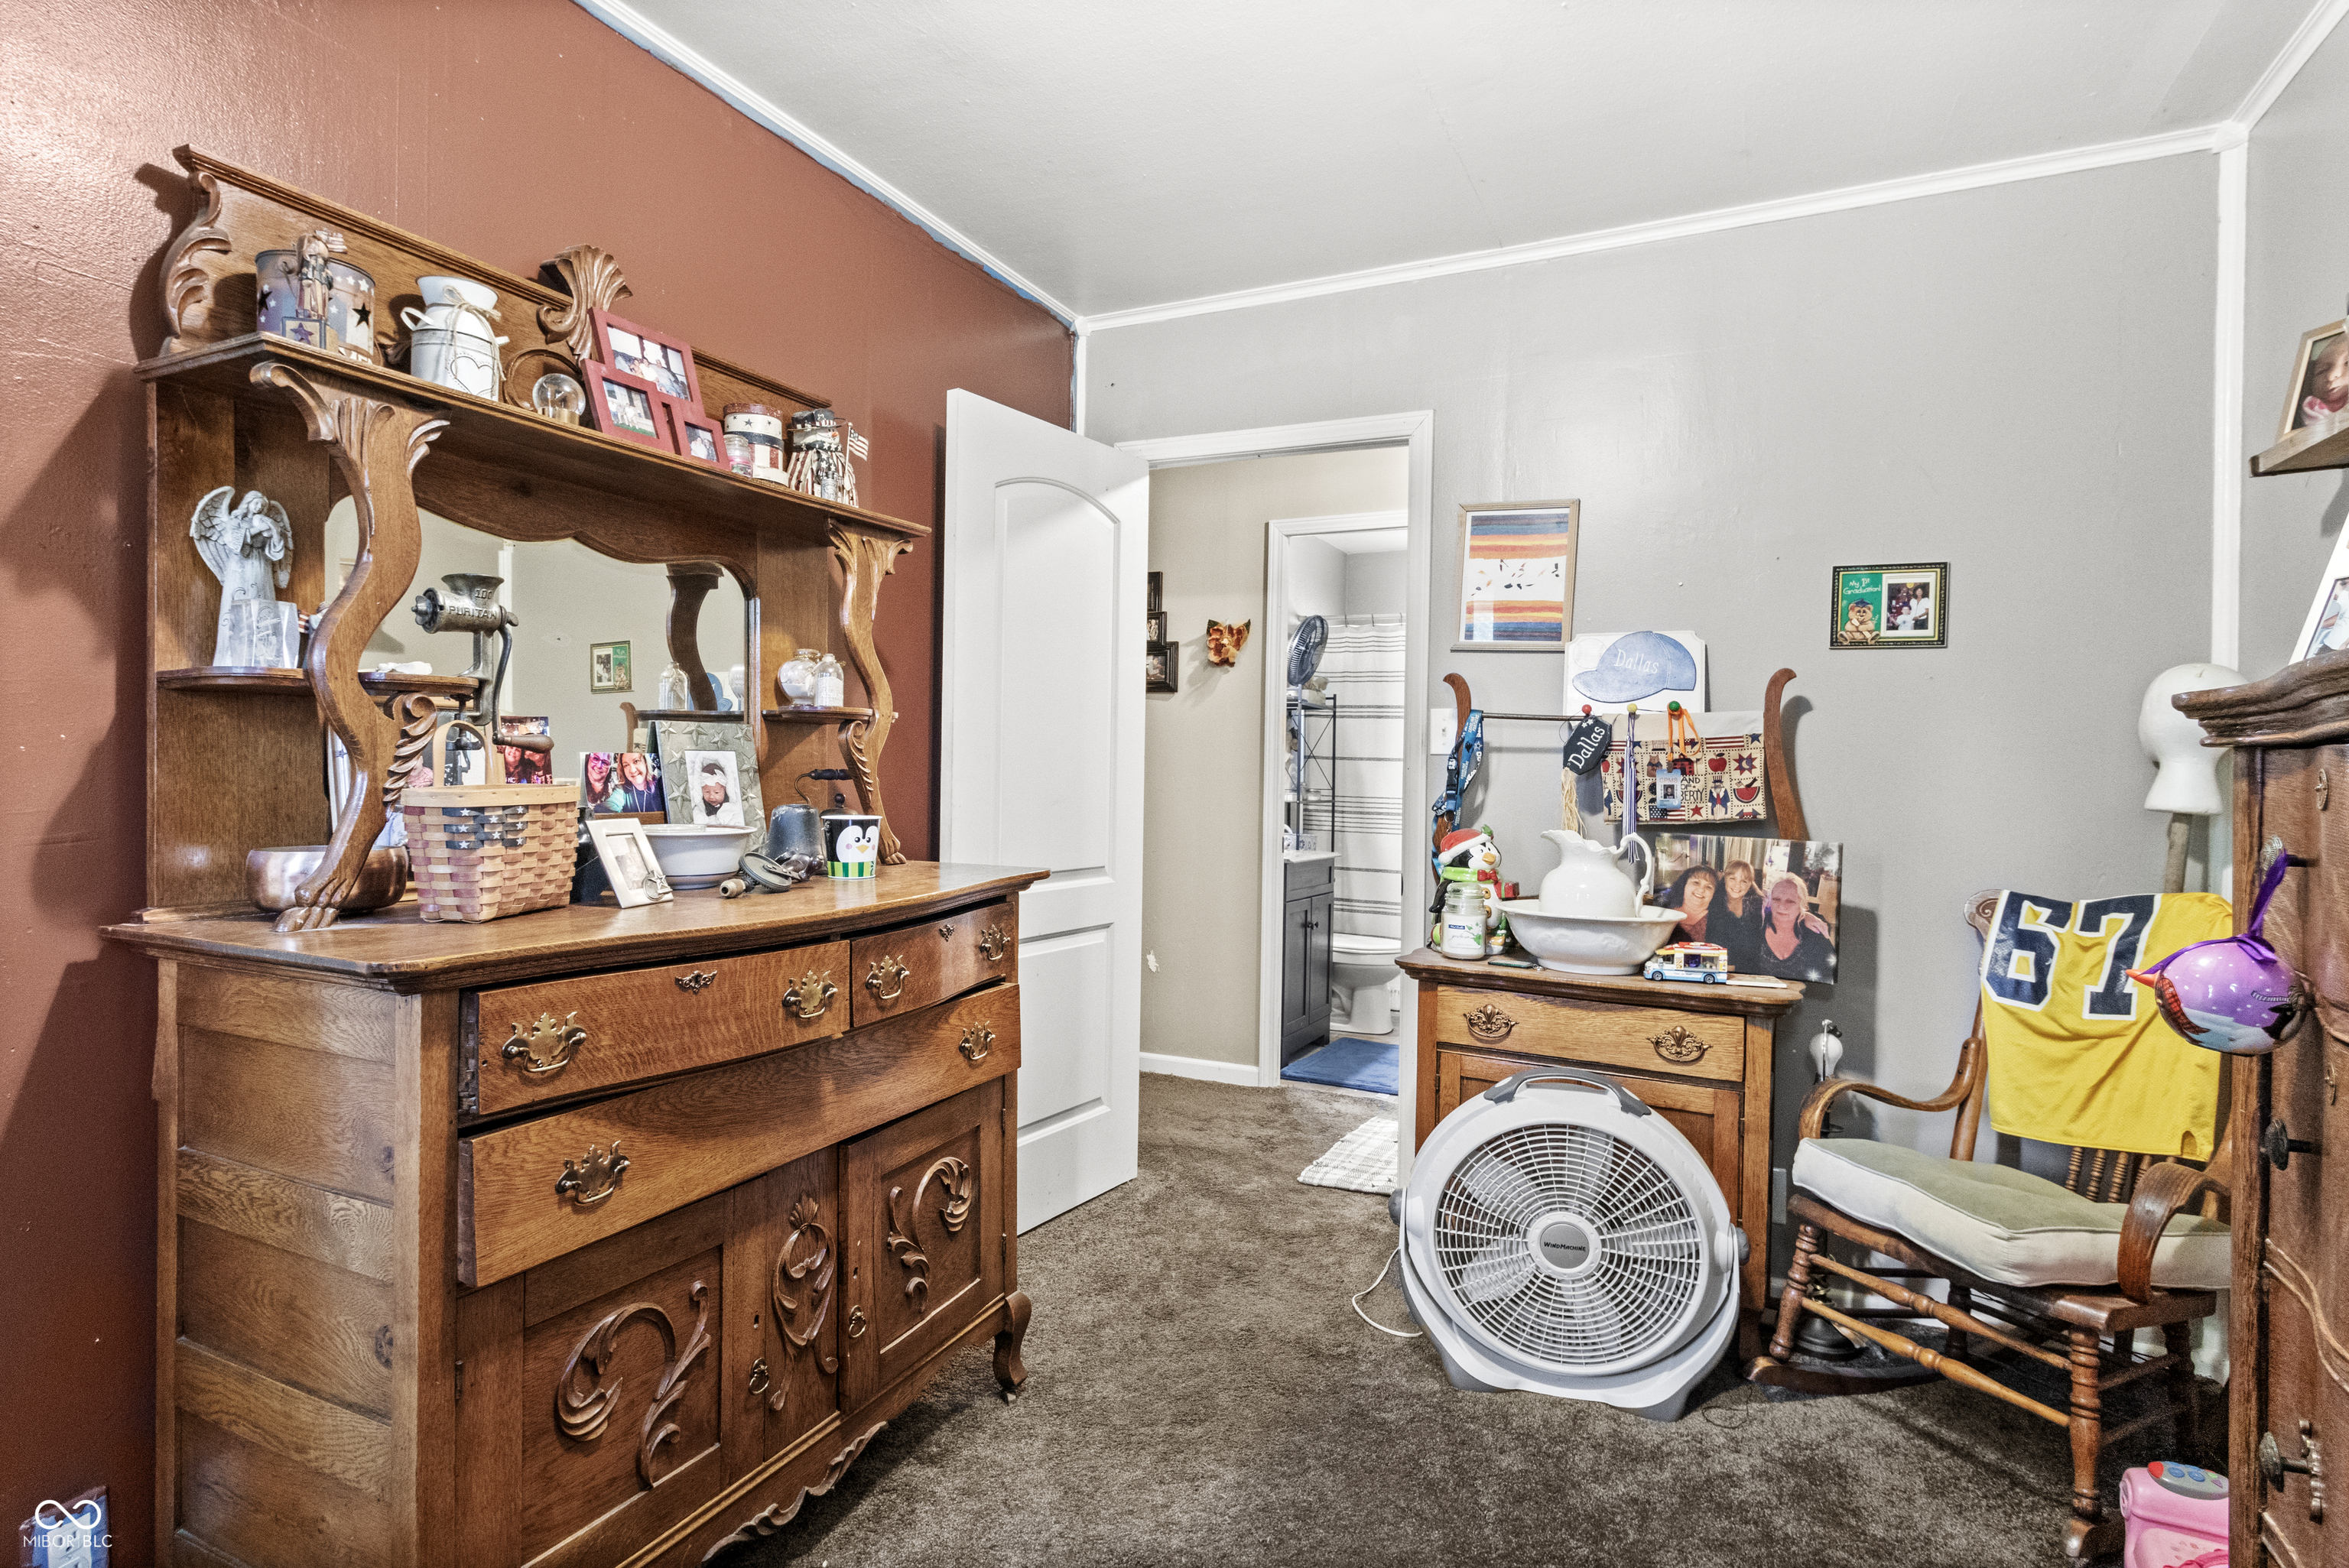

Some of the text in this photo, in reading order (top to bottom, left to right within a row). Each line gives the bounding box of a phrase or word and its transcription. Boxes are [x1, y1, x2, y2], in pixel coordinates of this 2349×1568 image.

[1849, 579, 1859, 588] My
[474, 588, 492, 599] 100
[448, 605, 497, 619] PURITAN
[1613, 648, 1659, 674] Dallas
[1568, 726, 1605, 769] Dallas
[1681, 776, 1701, 784] AND
[1981, 889, 2162, 1021] 67
